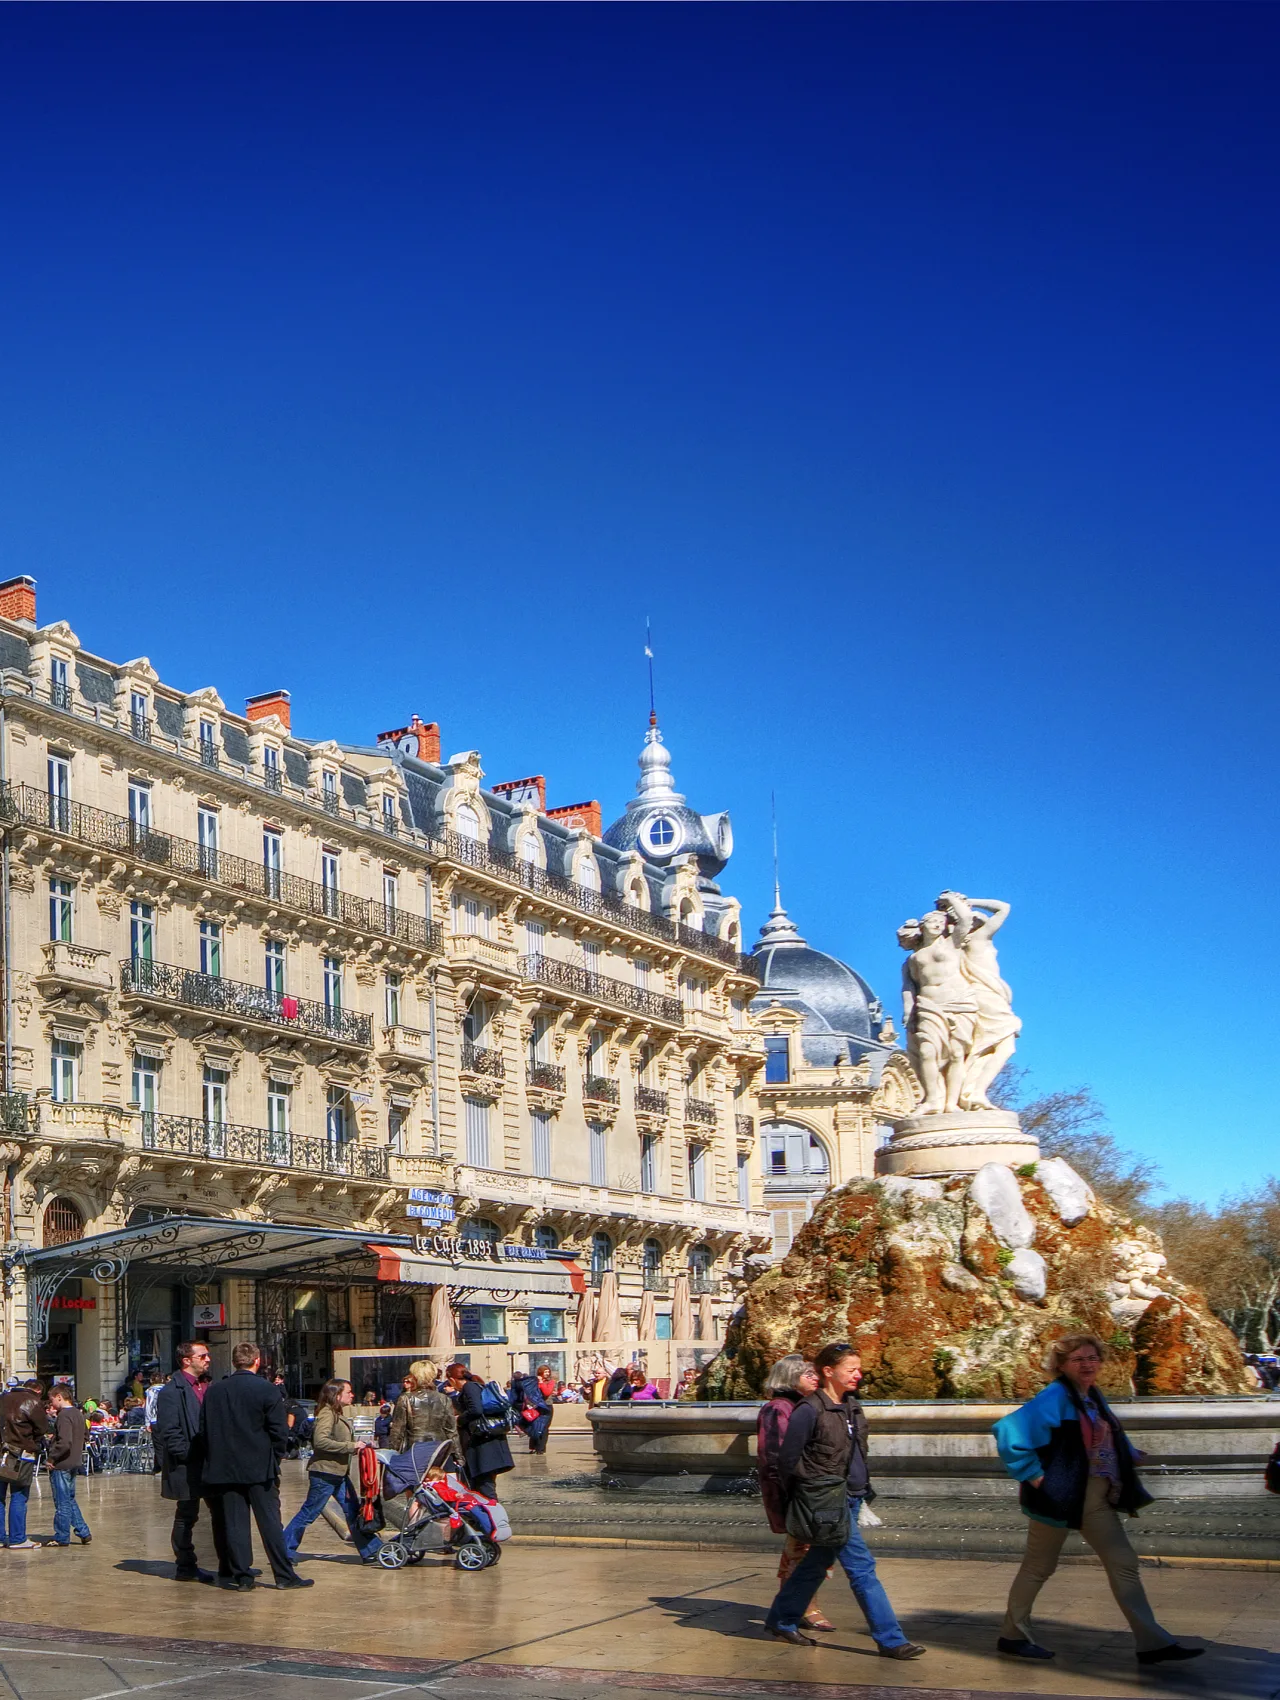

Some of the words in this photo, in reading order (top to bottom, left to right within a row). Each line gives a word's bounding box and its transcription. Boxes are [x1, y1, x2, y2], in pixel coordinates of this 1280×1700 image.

[434, 1235, 462, 1255] Café
[467, 1239, 491, 1256] 1893
[62, 1295, 96, 1309] Locker
